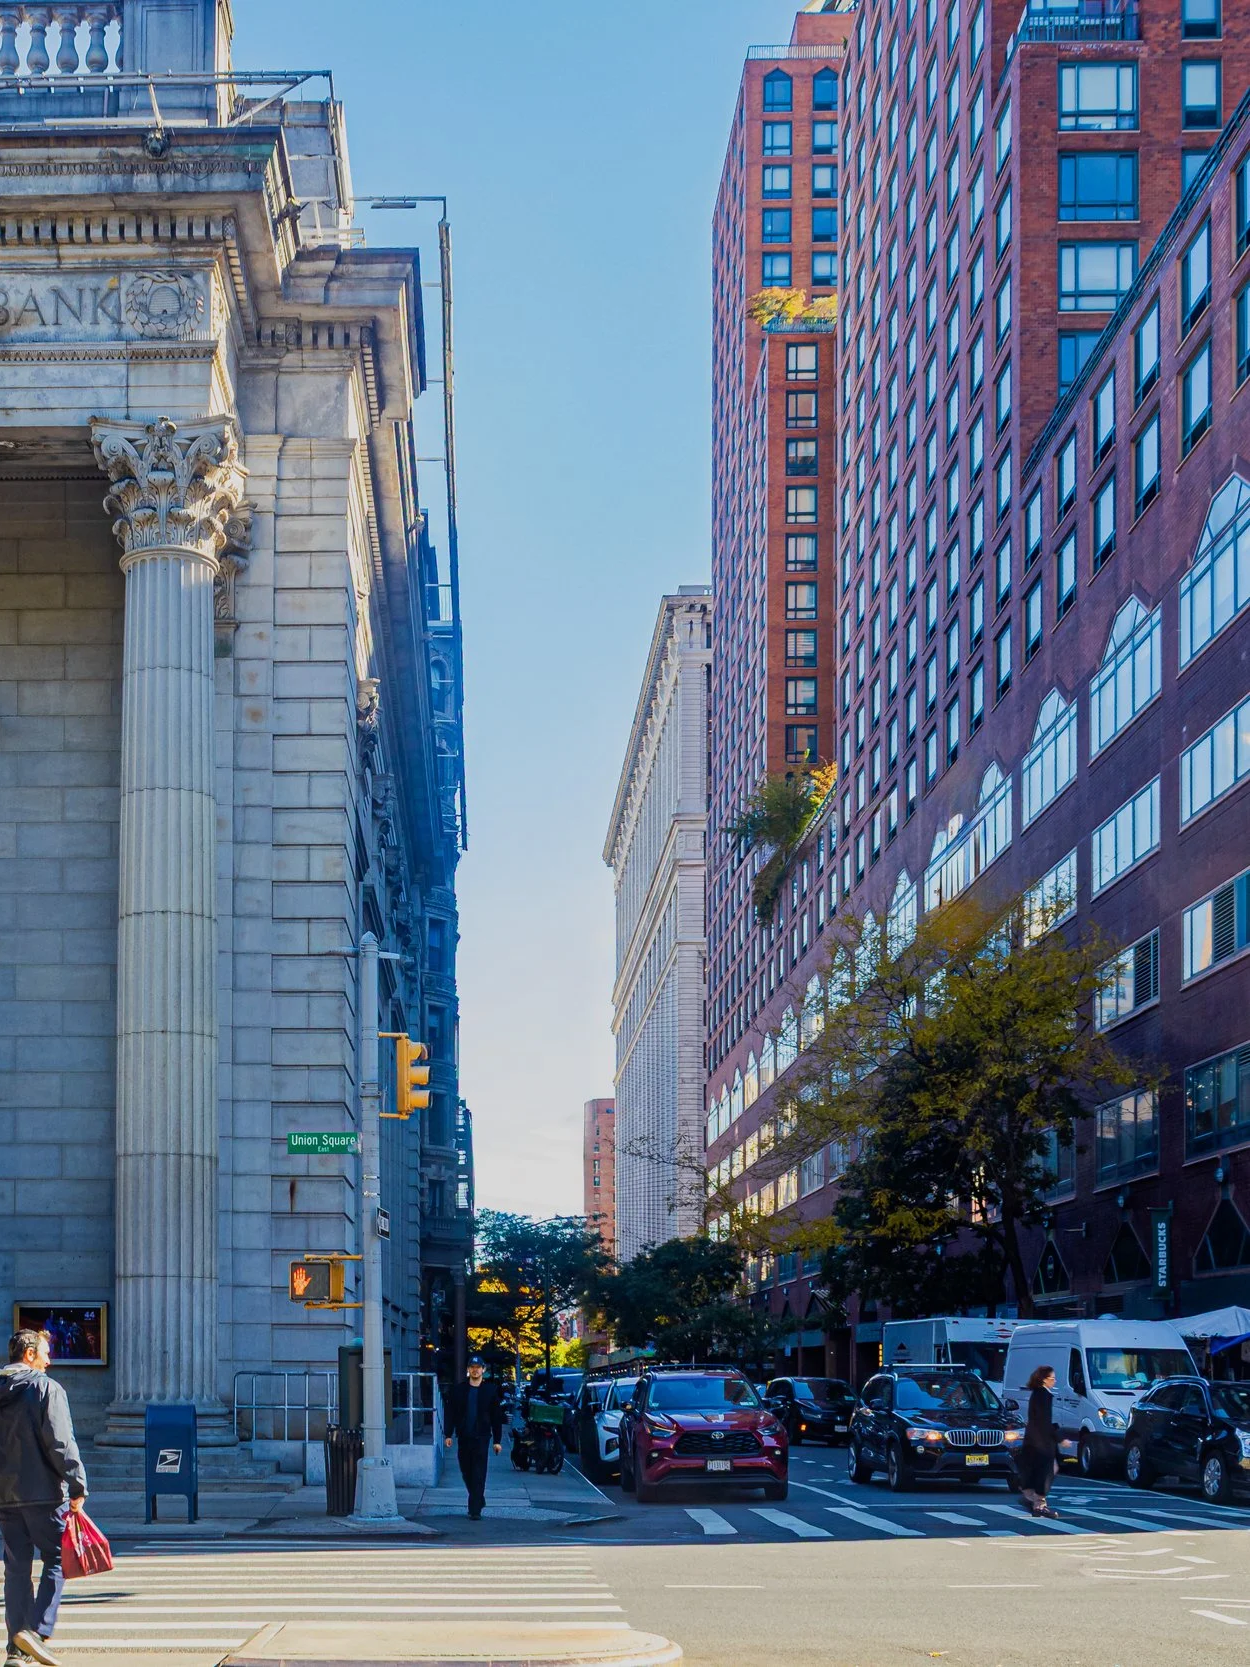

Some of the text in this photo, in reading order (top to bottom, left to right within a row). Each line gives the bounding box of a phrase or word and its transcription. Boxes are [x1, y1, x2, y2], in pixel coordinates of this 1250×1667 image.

[291, 1134, 356, 1148] Union Square
[1157, 1222, 1167, 1287] STARBUCKS
